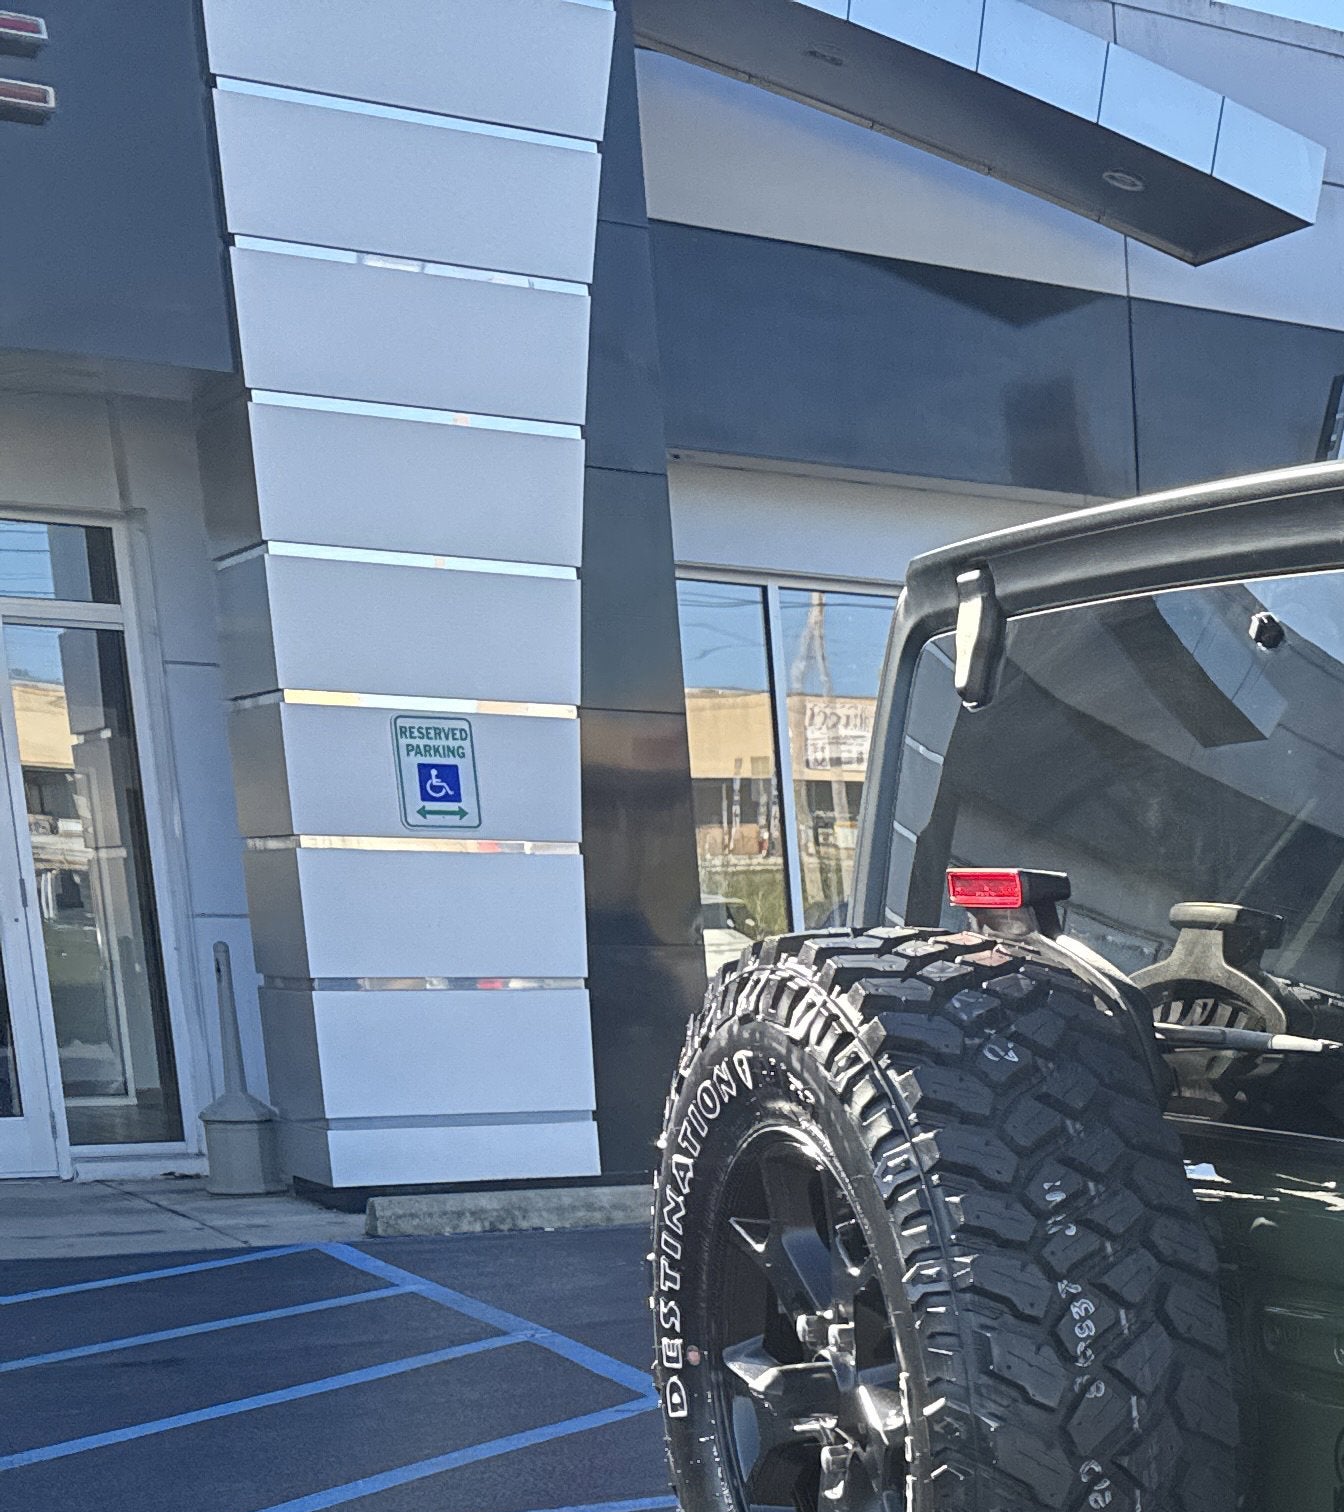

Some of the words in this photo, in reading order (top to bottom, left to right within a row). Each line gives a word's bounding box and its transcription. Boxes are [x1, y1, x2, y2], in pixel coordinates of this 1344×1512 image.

[399, 725, 468, 741] RESERVED
[405, 743, 466, 759] PARKING
[660, 1063, 738, 1418] DESTINATION
